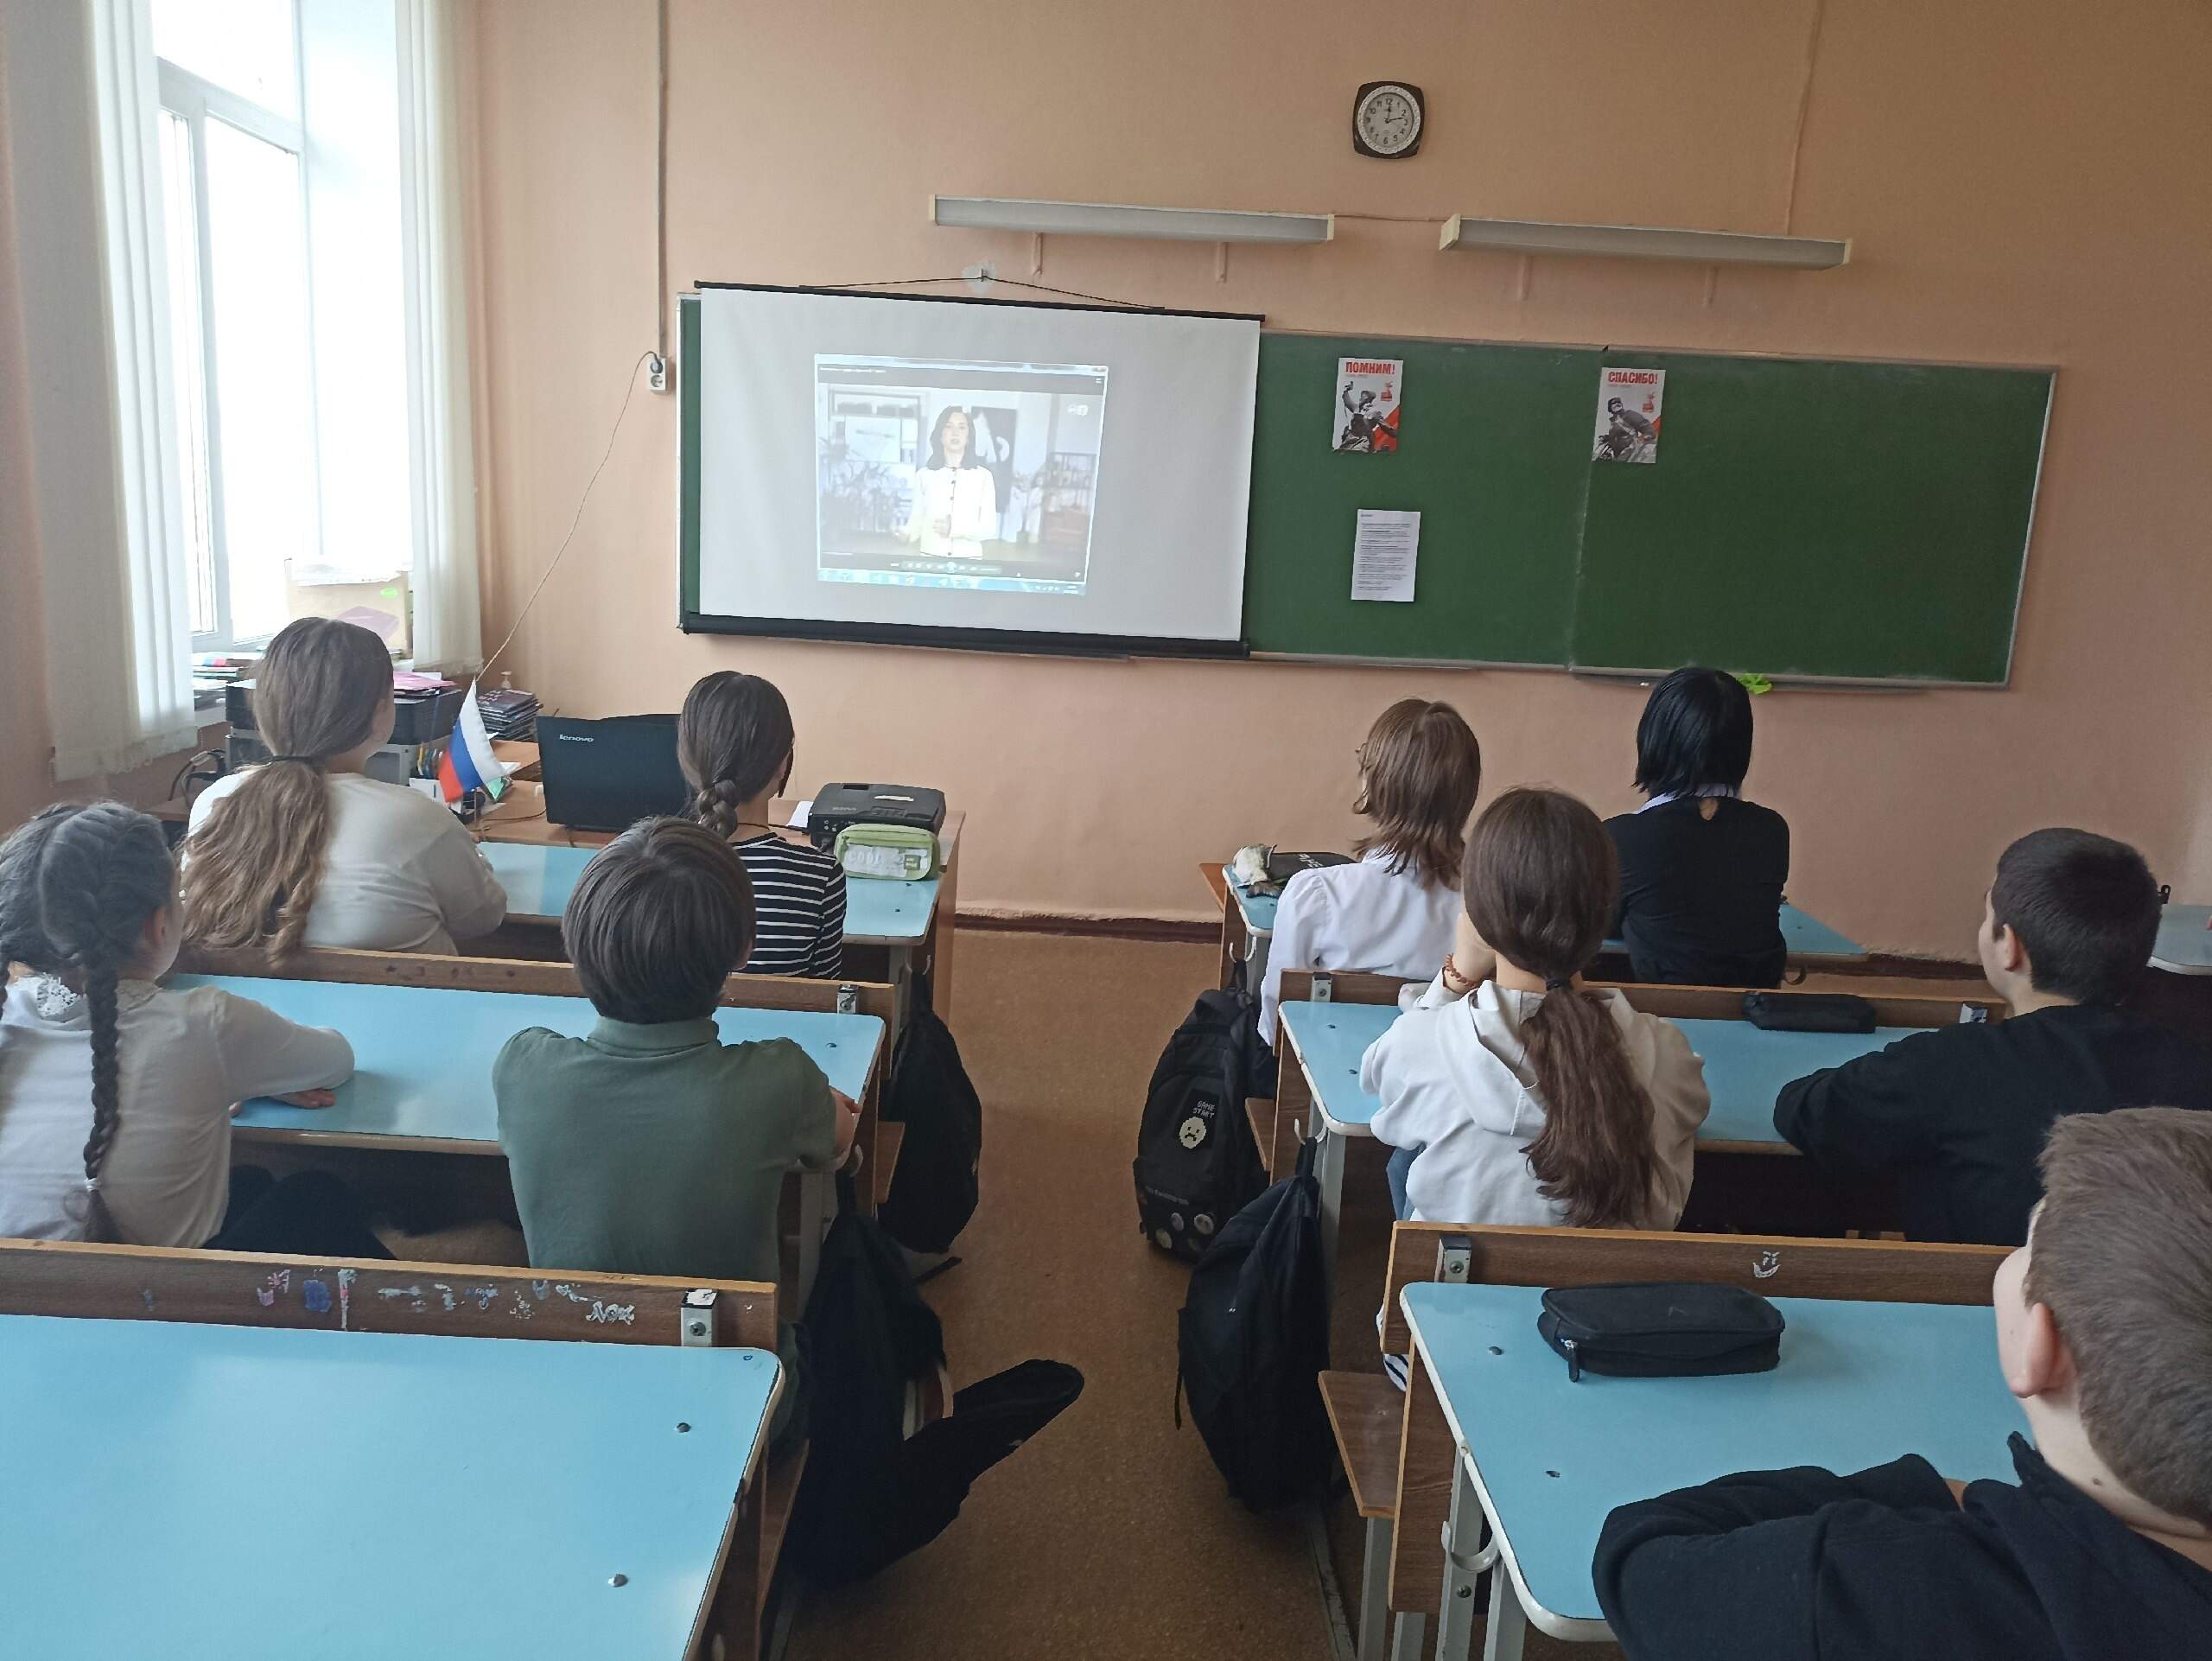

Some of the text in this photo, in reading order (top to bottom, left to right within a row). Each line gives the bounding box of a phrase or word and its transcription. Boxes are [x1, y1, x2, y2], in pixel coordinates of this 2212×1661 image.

[1346, 362, 1395, 375] ПОМНИМ!
[1608, 372, 1658, 385] СПАСИБО!
[560, 734, 594, 742] lenovo
[1198, 1100, 1216, 1111] GAME
[1192, 1107, 1215, 1118] START
